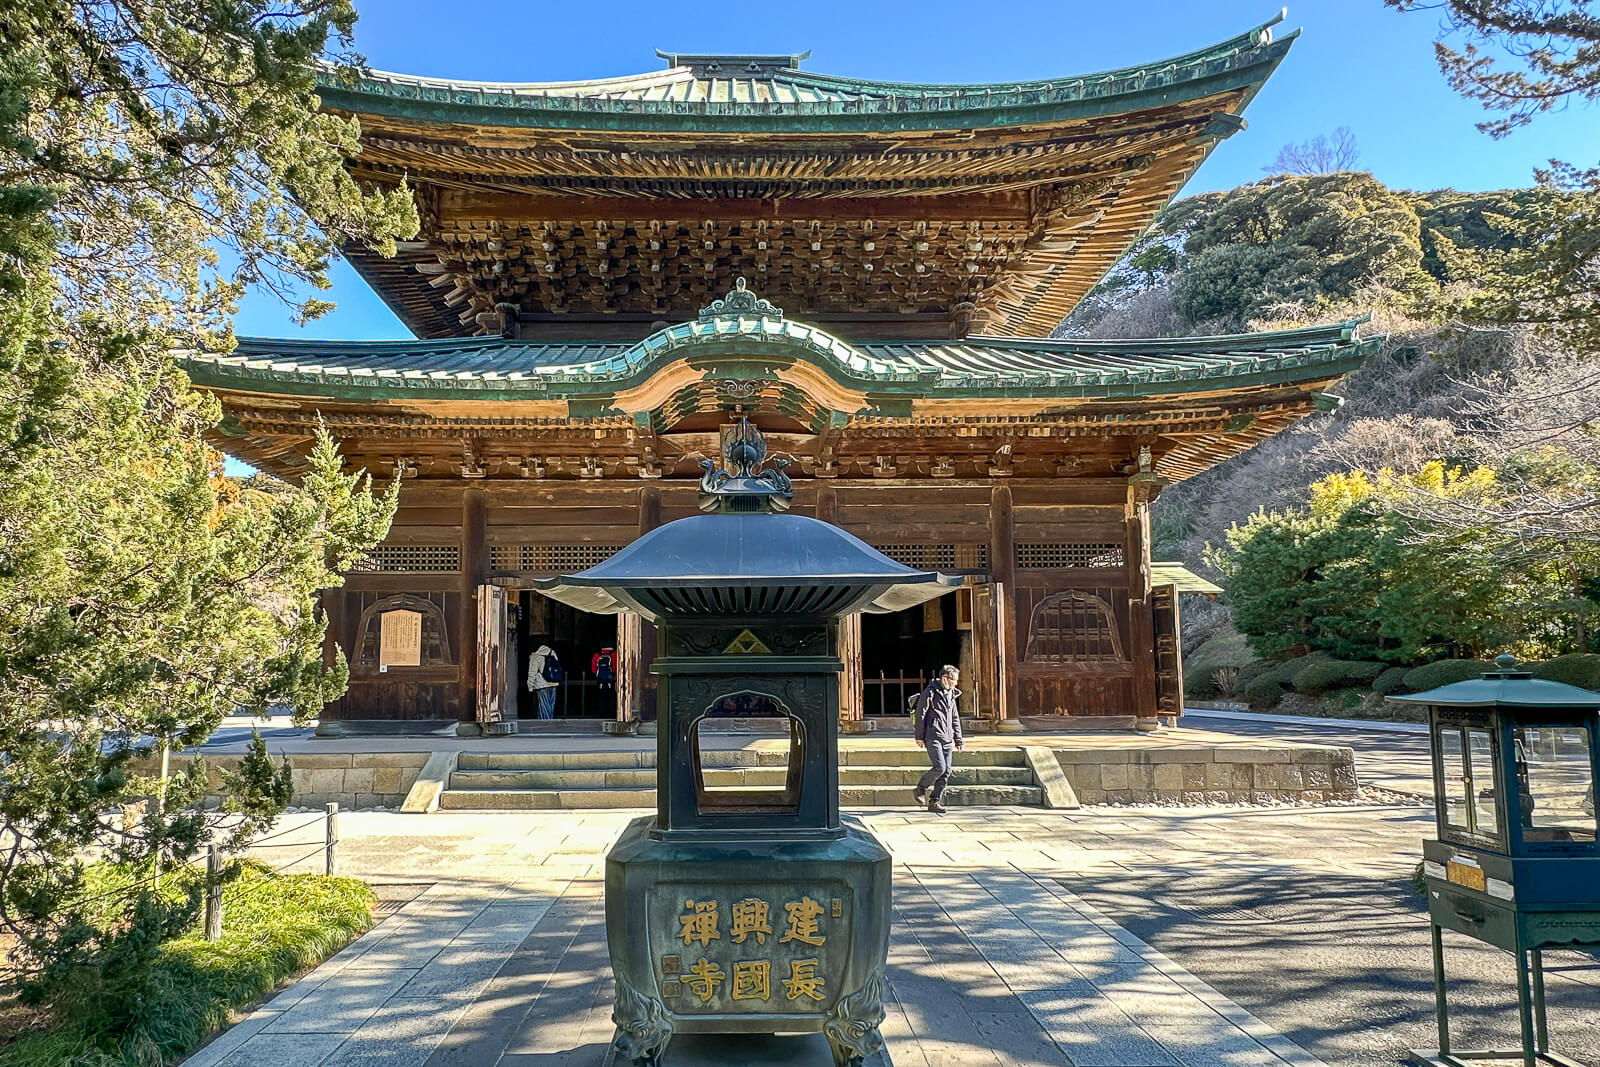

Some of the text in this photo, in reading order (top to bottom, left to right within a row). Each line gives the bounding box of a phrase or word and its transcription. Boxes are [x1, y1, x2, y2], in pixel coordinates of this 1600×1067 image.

[676, 899, 726, 1000] 禪寺
[730, 898, 772, 1000] 興國
[779, 896, 826, 1000] 建長
